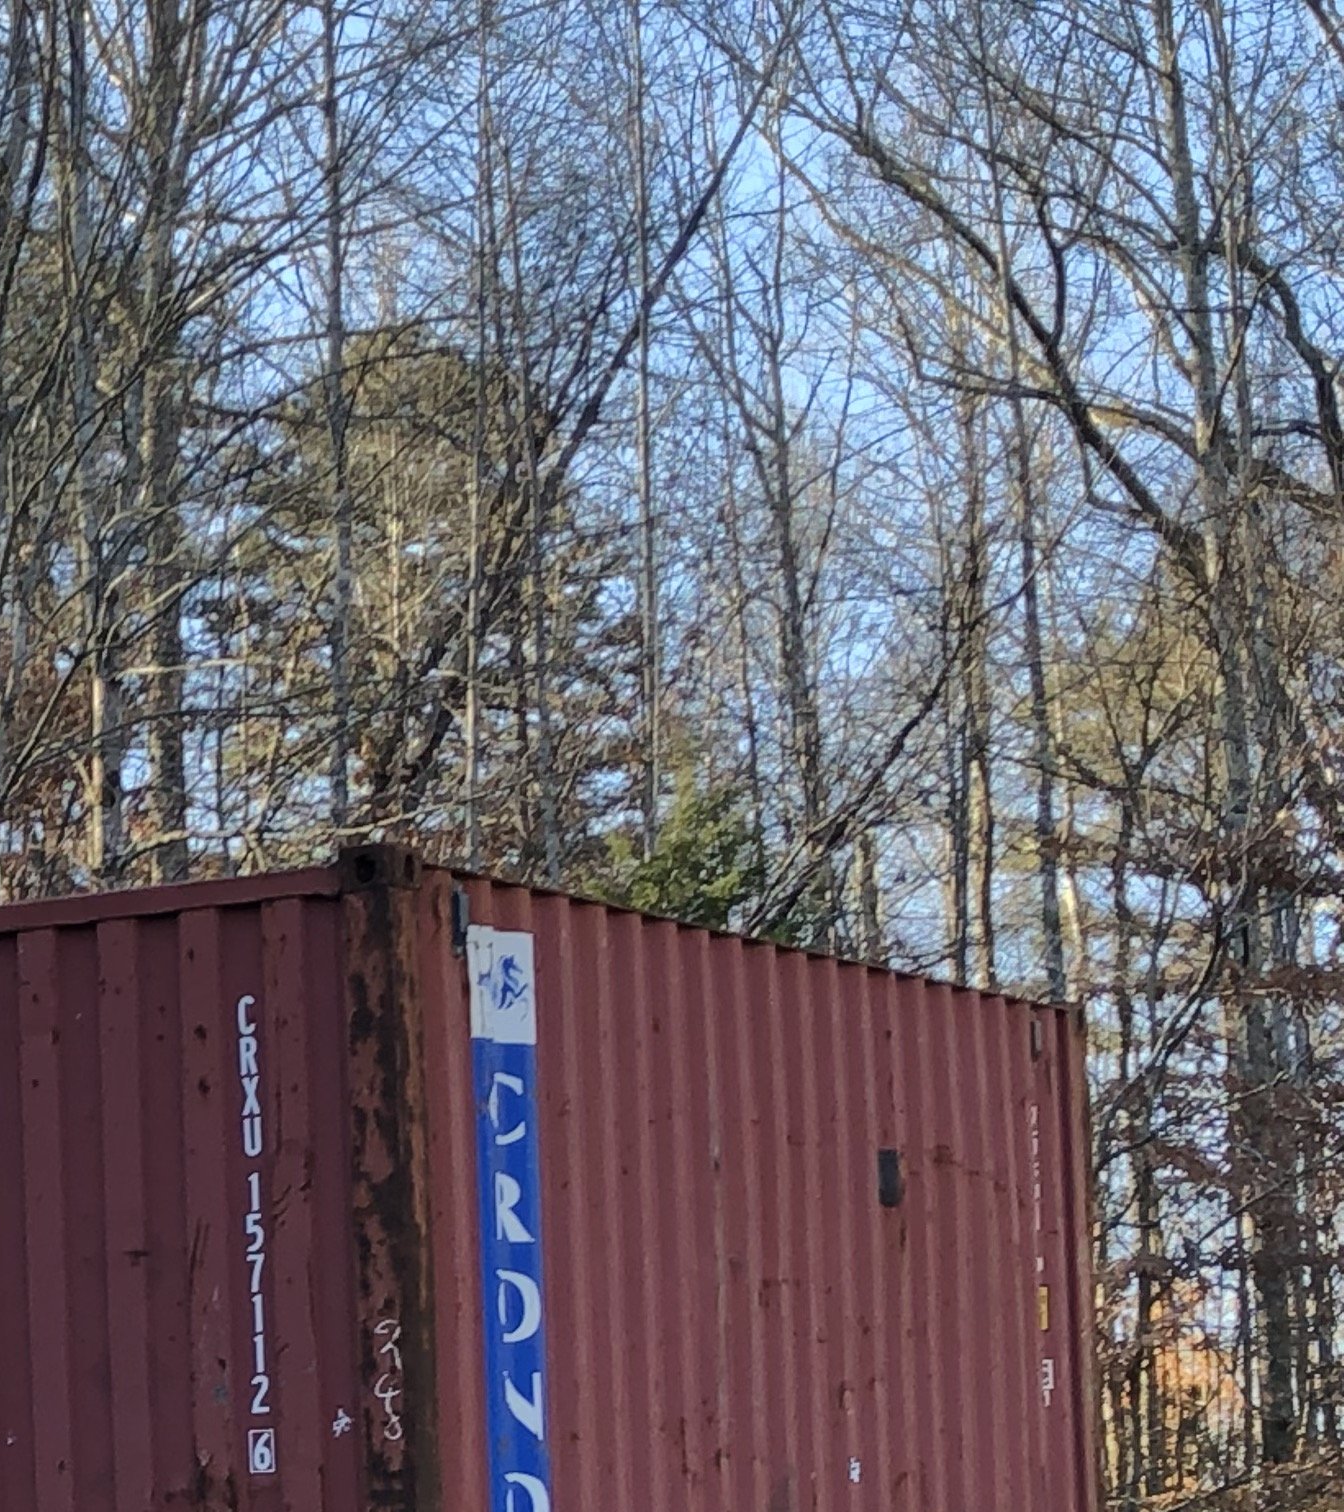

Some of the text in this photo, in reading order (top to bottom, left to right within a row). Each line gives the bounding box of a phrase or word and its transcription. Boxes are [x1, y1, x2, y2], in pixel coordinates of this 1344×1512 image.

[237, 995, 273, 1471] CRXU 157112 6
